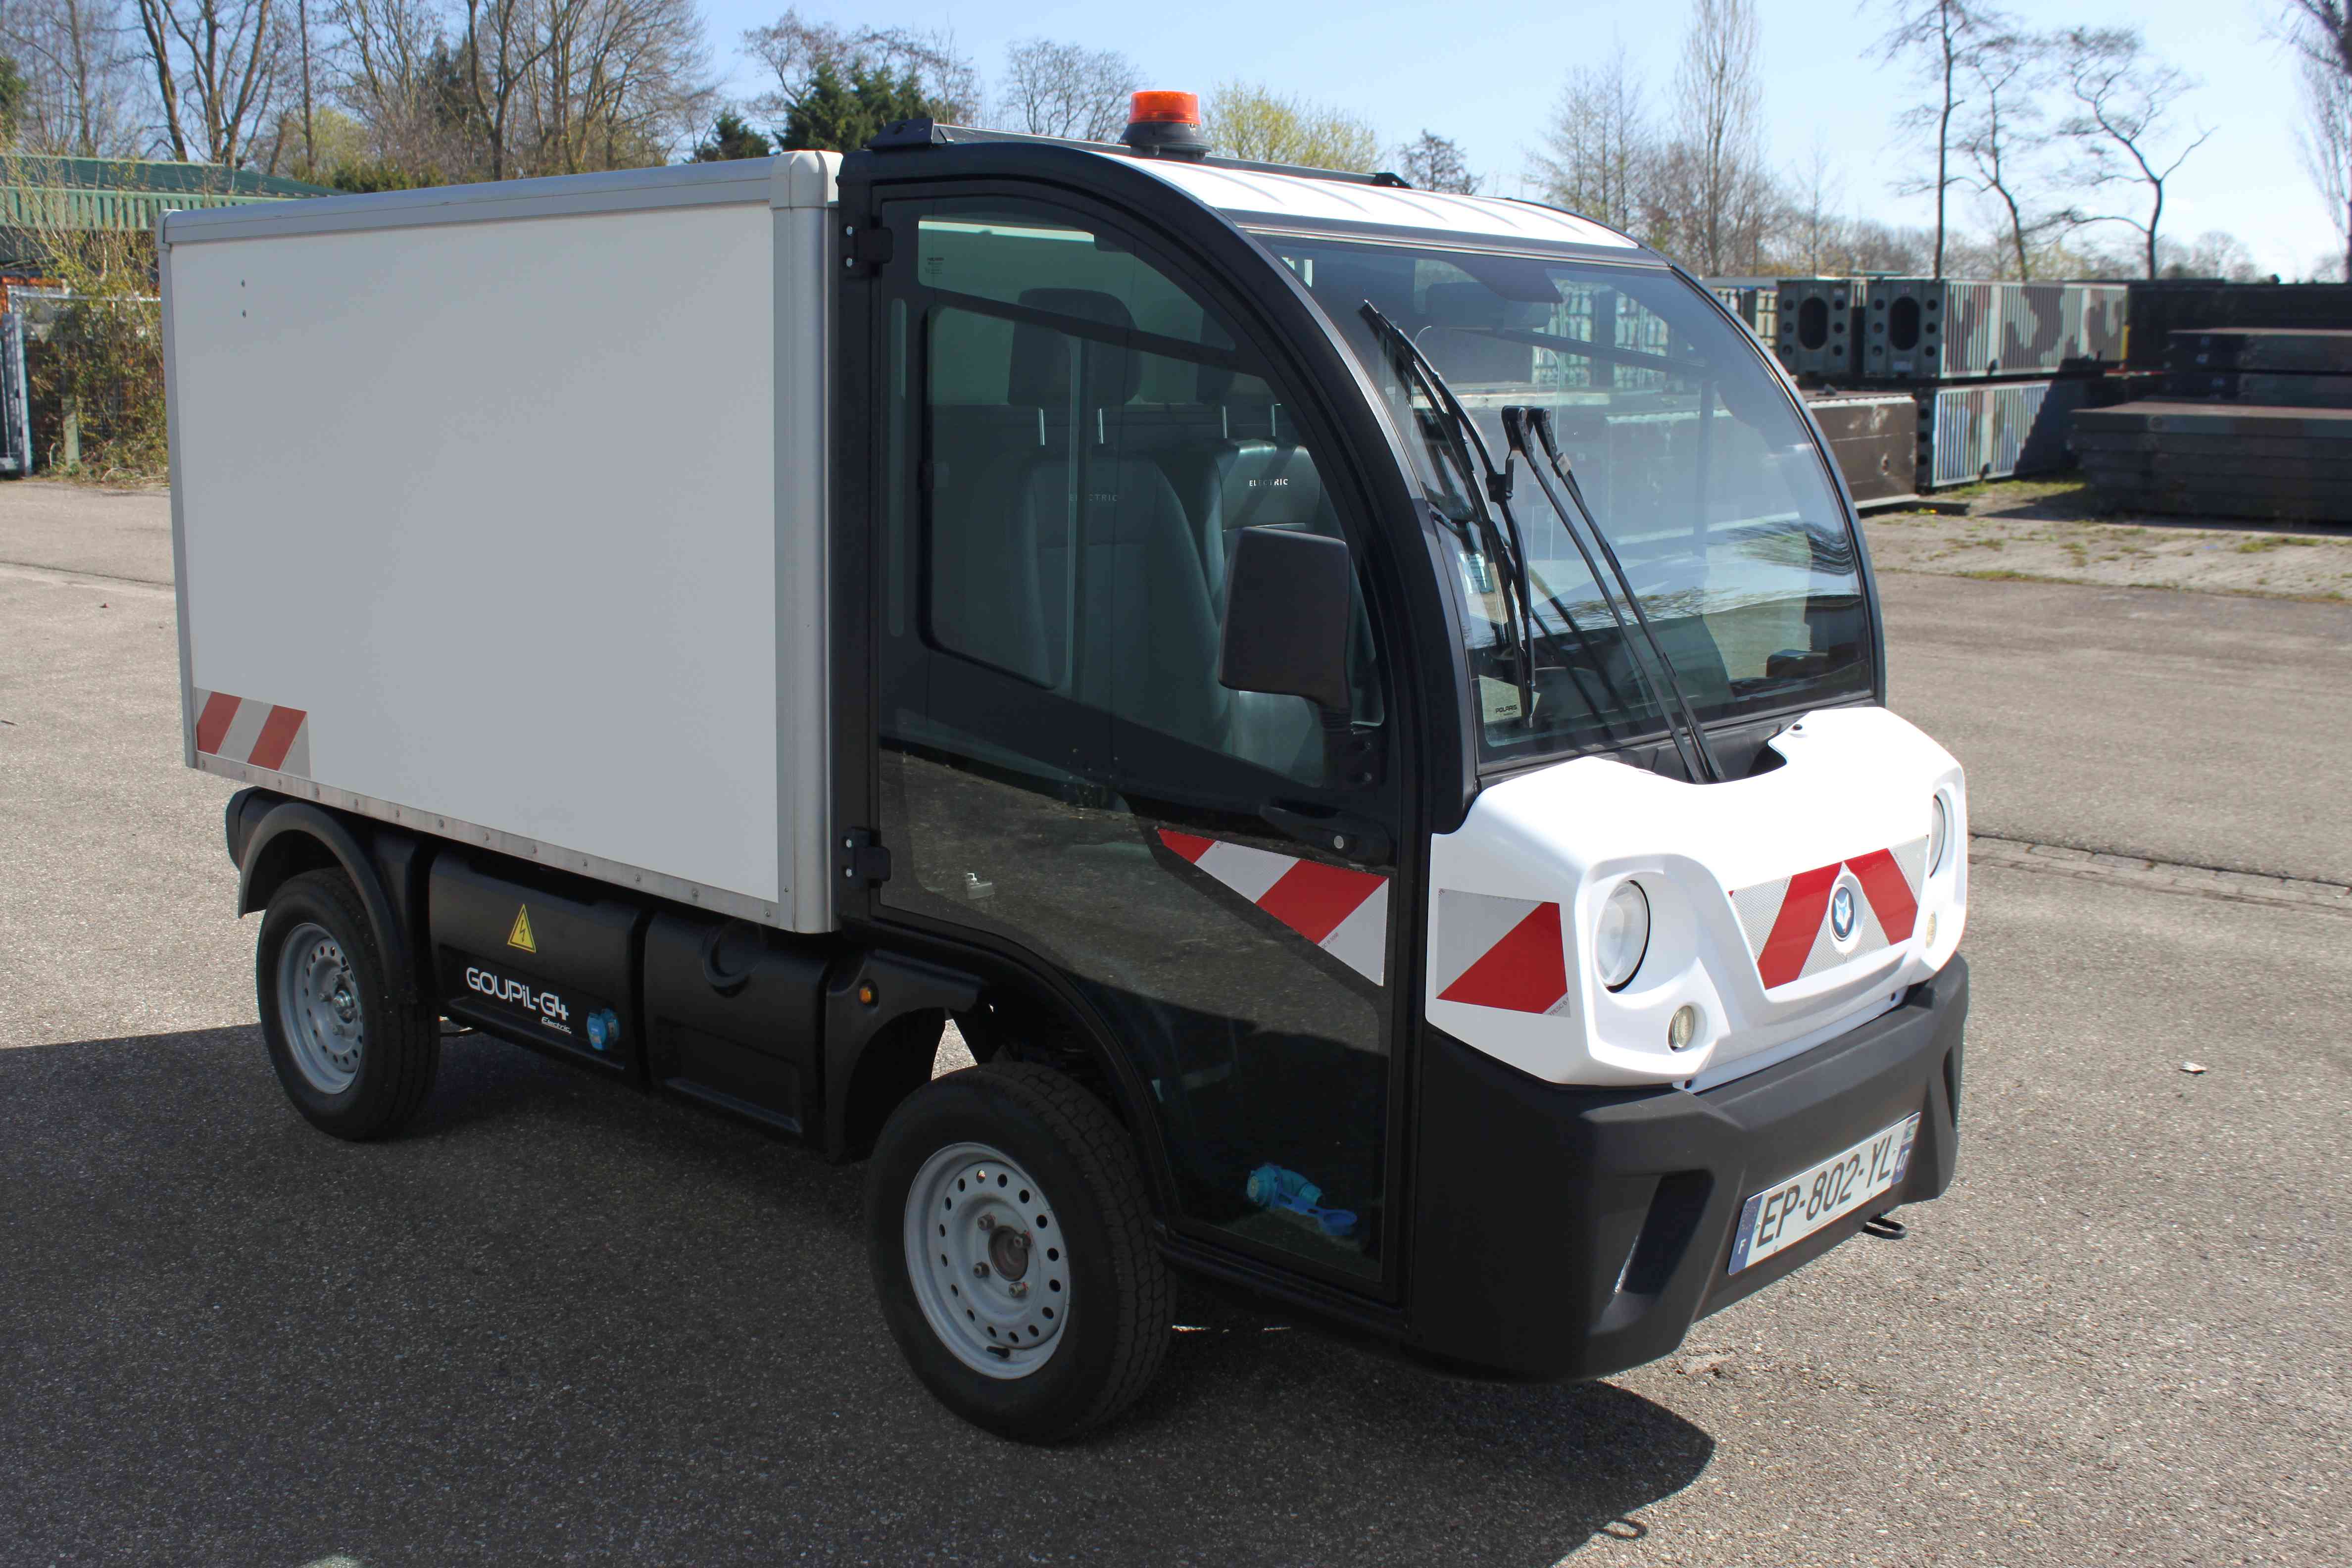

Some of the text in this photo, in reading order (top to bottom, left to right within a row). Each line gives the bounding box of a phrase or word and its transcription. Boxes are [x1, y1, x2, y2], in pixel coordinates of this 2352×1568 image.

[1249, 478, 1289, 487] ELECTRIC
[1496, 704, 1517, 713] POLARIS
[1756, 1135, 1893, 1248] EP-802-YL
[1738, 1238, 1747, 1254] F
